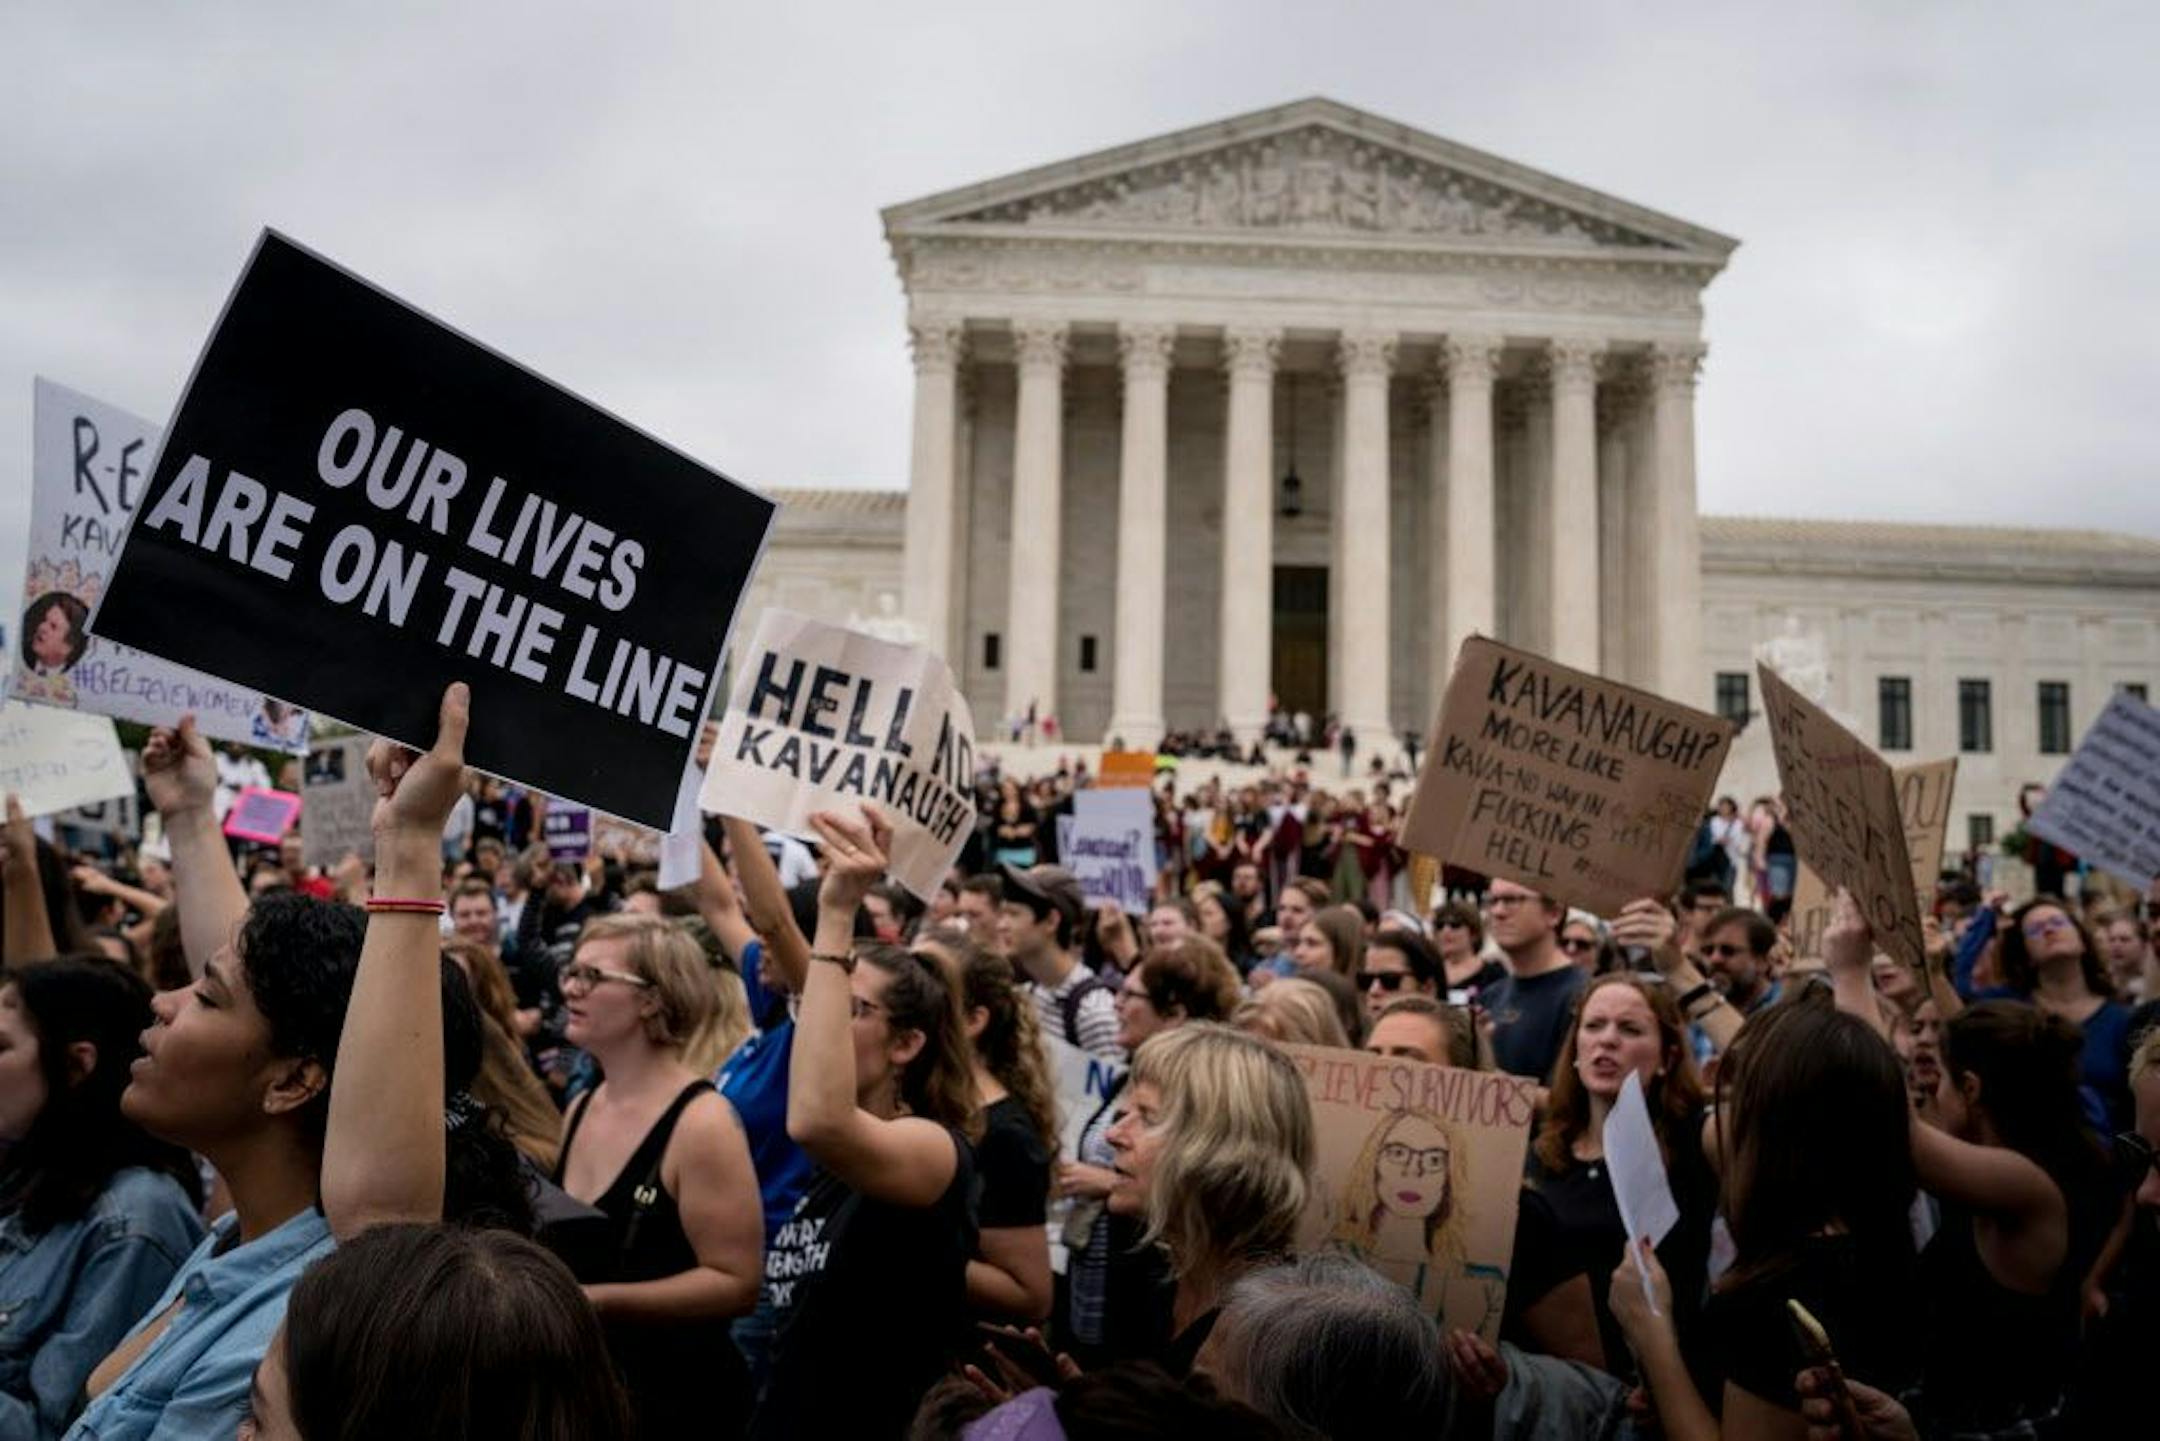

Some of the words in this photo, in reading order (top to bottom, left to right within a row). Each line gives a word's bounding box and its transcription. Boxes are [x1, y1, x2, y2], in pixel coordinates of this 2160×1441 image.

[317, 409, 468, 535] OUR
[467, 477, 645, 611] LIVES
[145, 455, 316, 581] ARE
[320, 525, 429, 627] ON
[437, 567, 565, 683] THE
[565, 625, 706, 739] LINE
[749, 651, 912, 758] HELL
[932, 711, 975, 800] NO
[1482, 711, 1561, 763] MORE
[1567, 749, 1624, 783] LIKE
[1489, 656, 1720, 770] KAVANAUGH?
[736, 725, 969, 845] KAVANAUGH
[1472, 789, 1592, 850] FUCKING
[1486, 832, 1555, 878] HELL
